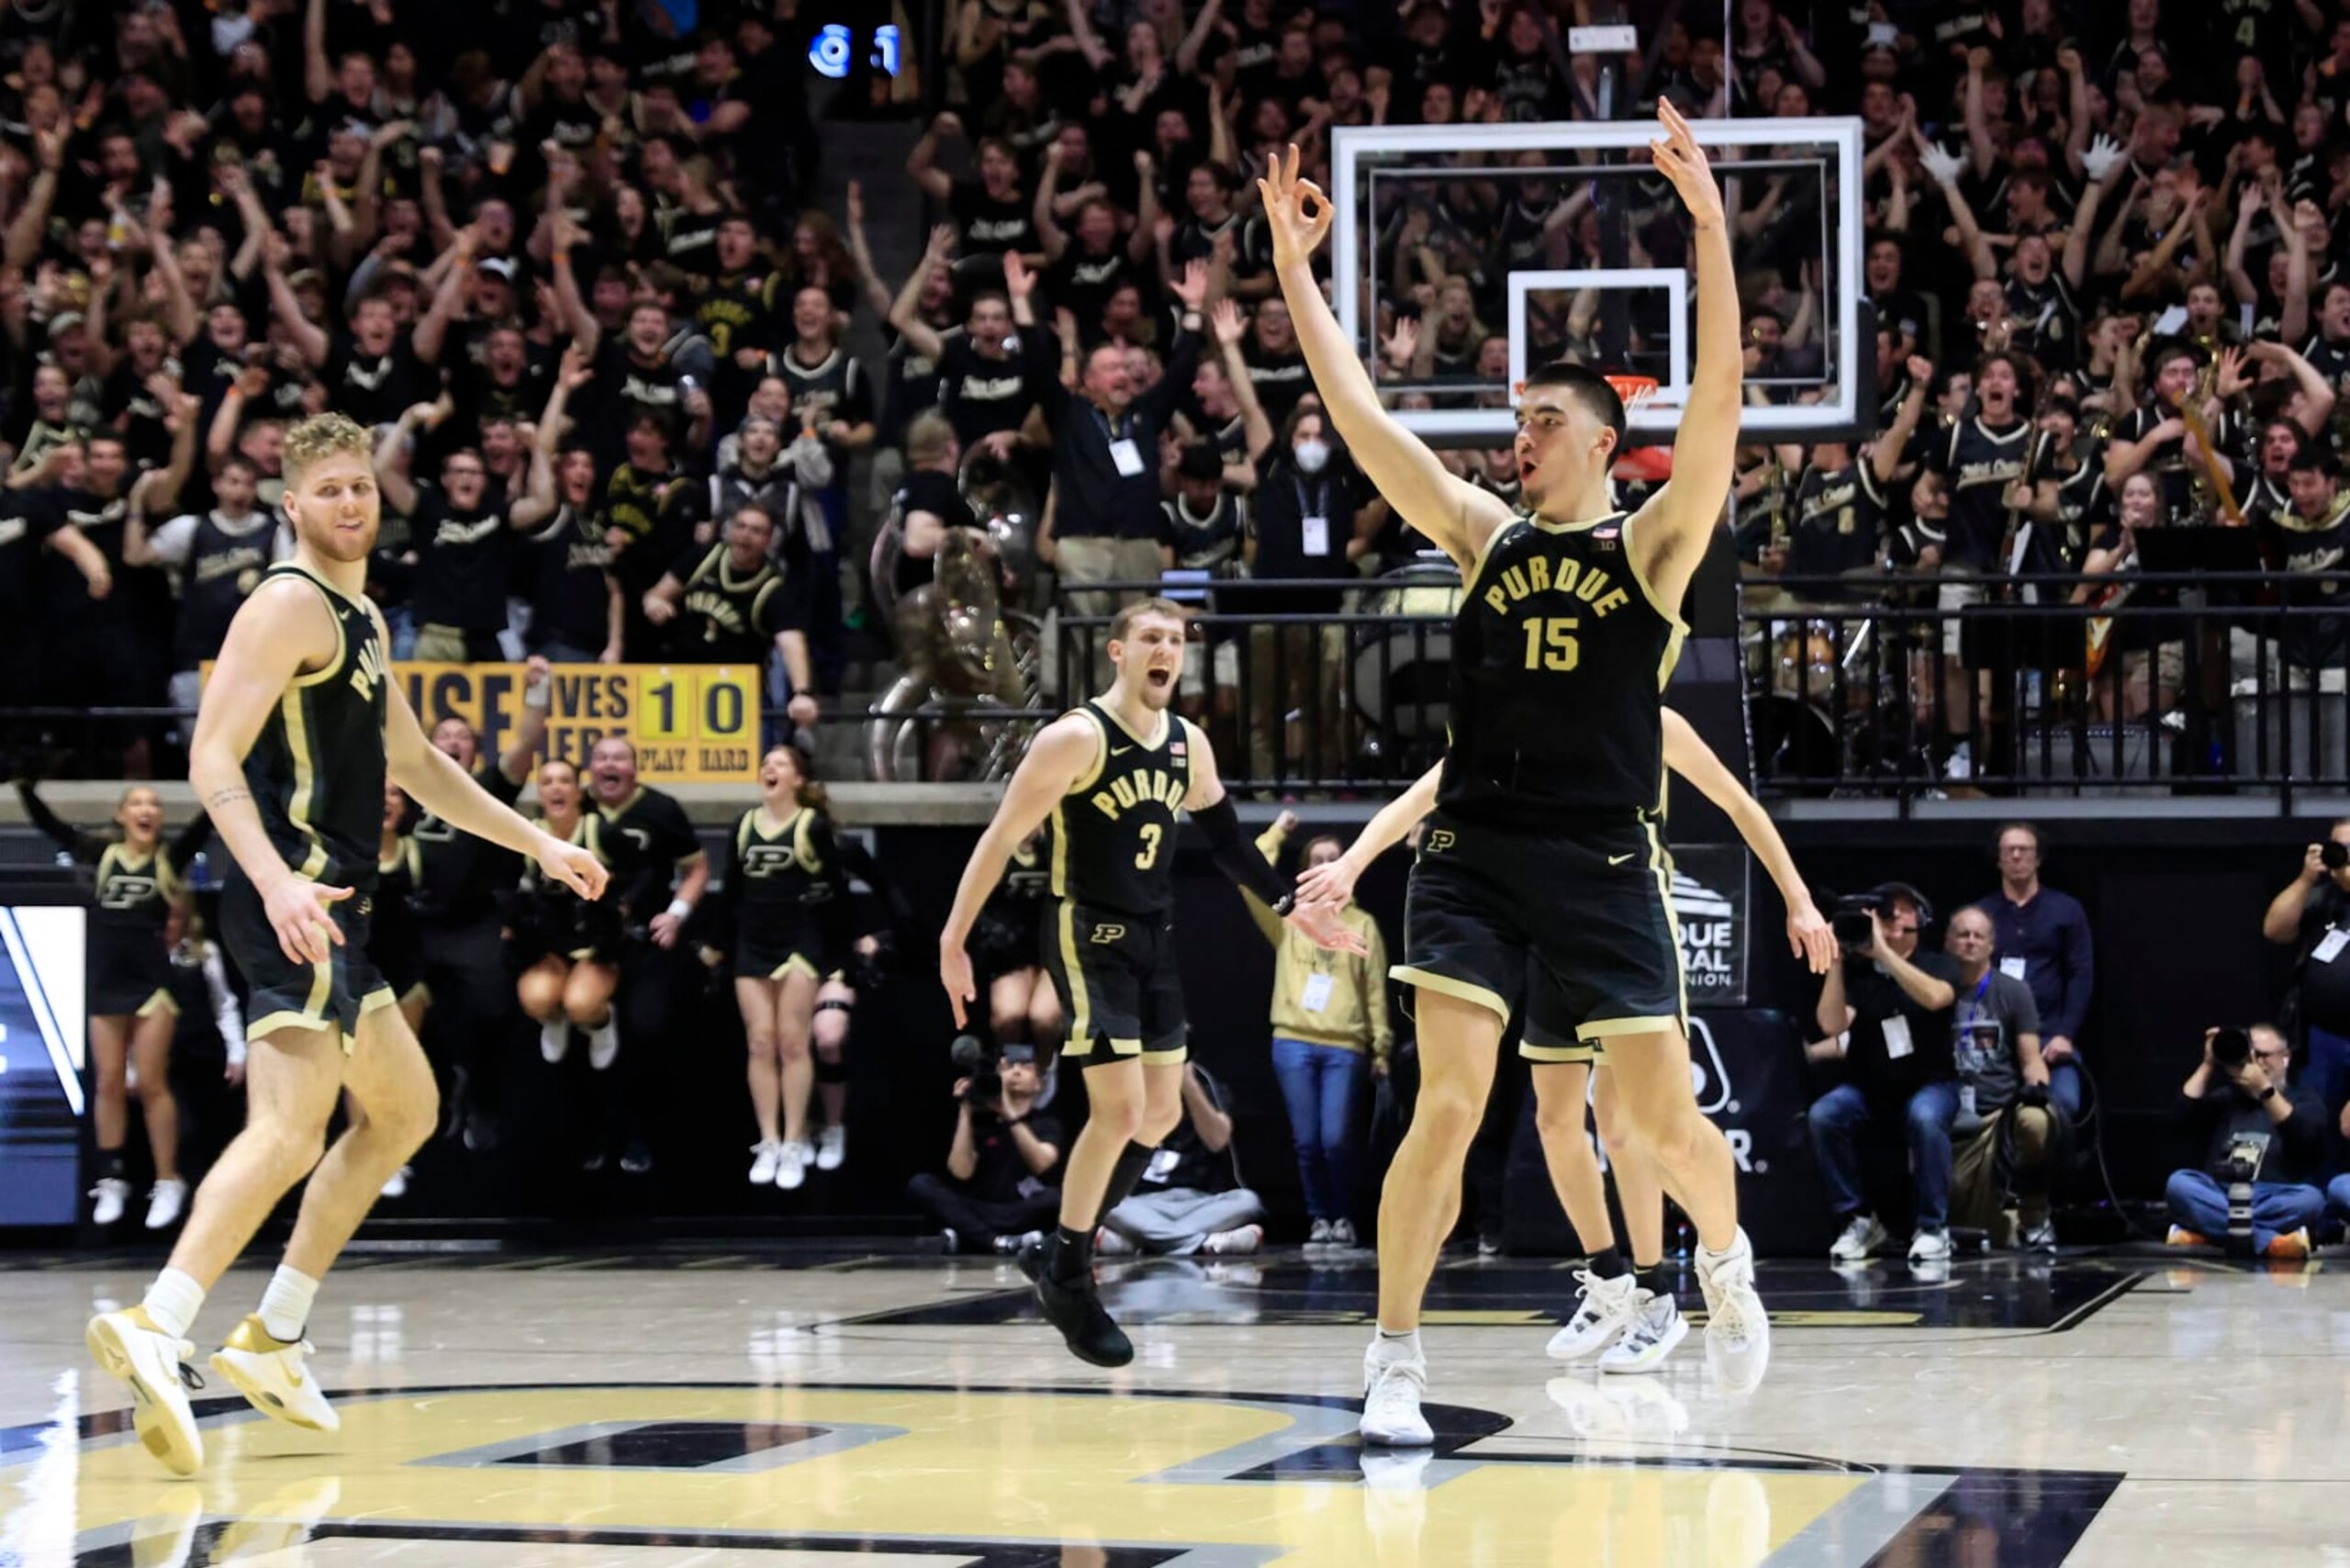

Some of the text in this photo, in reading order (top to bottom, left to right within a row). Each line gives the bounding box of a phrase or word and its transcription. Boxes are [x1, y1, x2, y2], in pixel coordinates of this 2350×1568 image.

[1484, 554, 1630, 618] PURDUE
[1522, 617, 1580, 671] 15
[640, 747, 749, 772] PLAY HARD
[1135, 823, 1163, 870] 3
[1426, 830, 1456, 853] P
[744, 845, 795, 878] P
[101, 874, 156, 910] P
[1090, 923, 1126, 944] P
